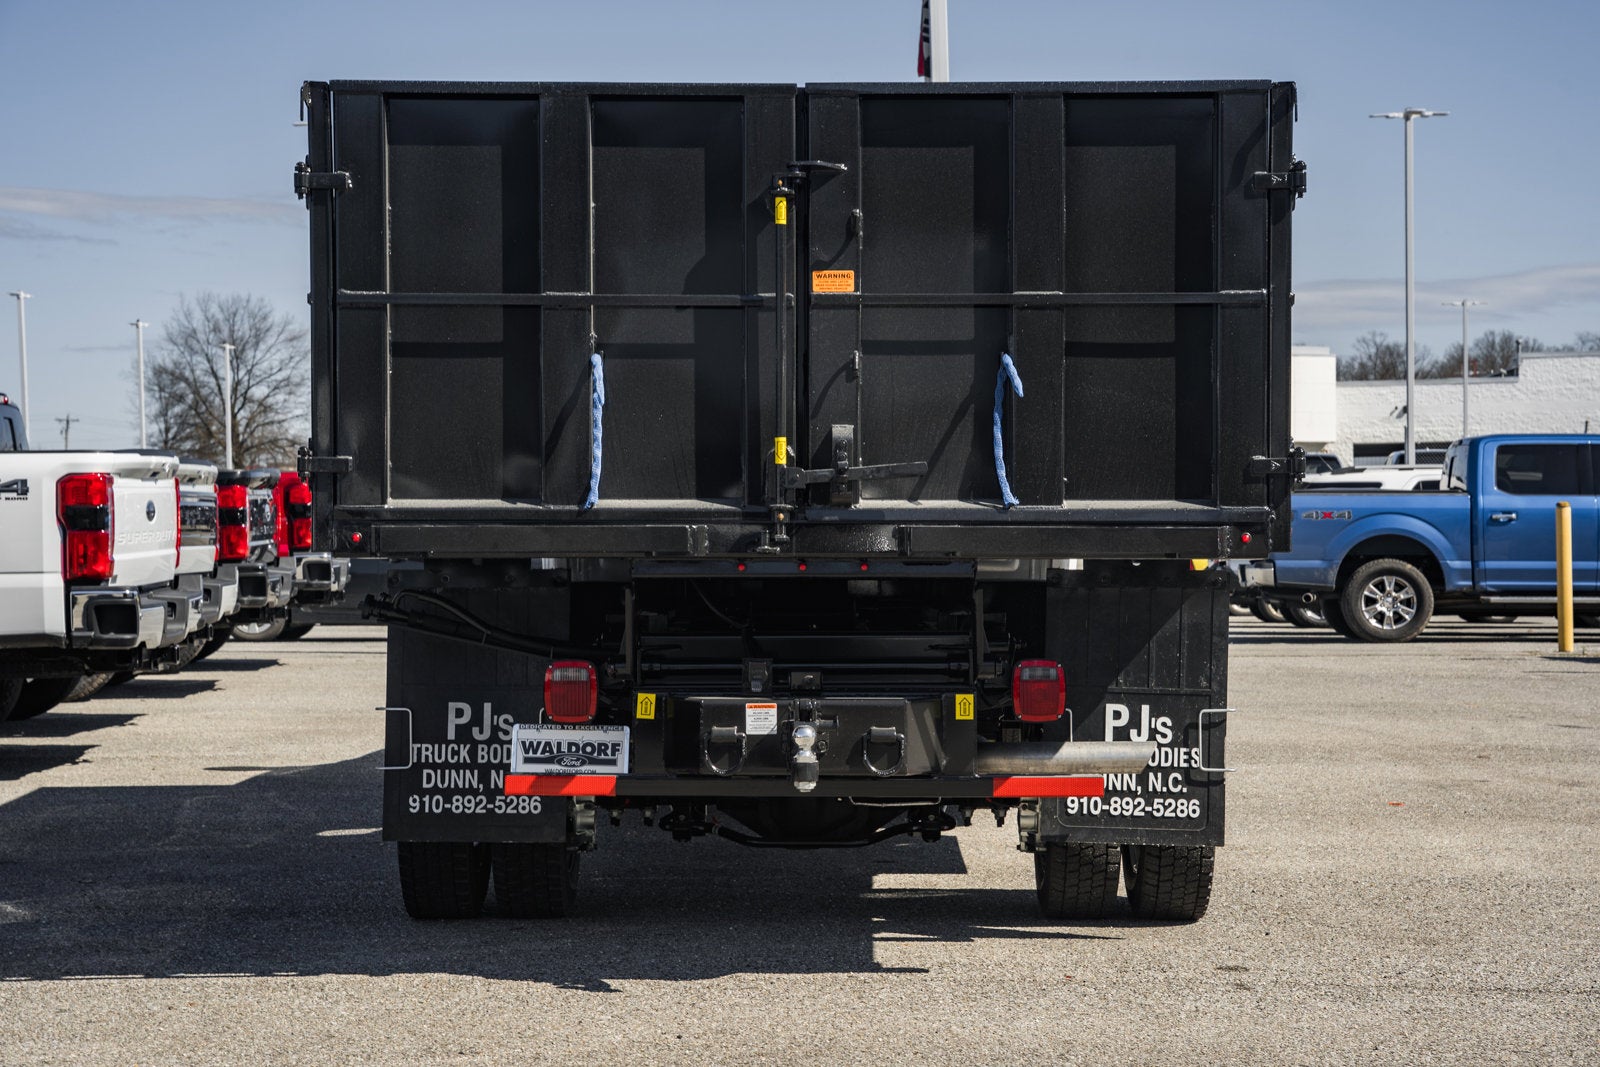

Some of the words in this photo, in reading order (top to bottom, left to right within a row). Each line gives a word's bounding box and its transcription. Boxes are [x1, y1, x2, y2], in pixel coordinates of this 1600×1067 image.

[118, 530, 154, 545] SUPER
[411, 743, 471, 764] TRUCK
[477, 743, 512, 763] BOD
[520, 740, 622, 757] WALDORF
[1148, 747, 1200, 768] ODIES
[561, 756, 582, 767] Ford
[421, 769, 484, 791] DUNN,
[1104, 772, 1142, 795] NN,
[1148, 772, 1188, 793] N.C.
[408, 795, 542, 814] 910-892-5286
[1066, 796, 1200, 818] 910-892-5286
